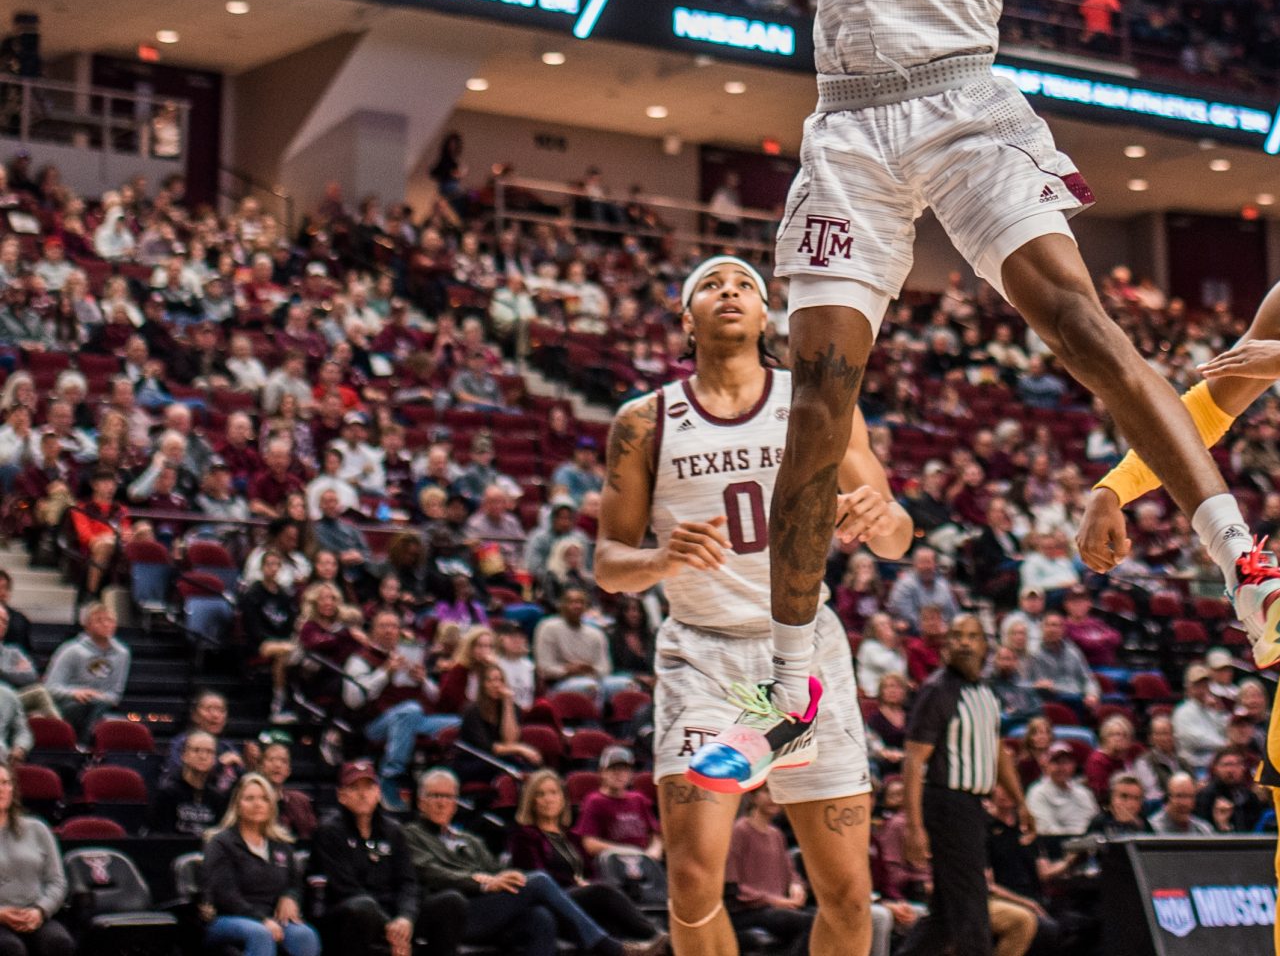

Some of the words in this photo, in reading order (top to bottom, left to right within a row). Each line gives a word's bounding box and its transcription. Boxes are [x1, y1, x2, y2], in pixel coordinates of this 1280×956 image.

[672, 6, 796, 56] NISSAN
[671, 448, 750, 480] TEXAS
[723, 480, 770, 555] 0
[1190, 884, 1277, 927] MUSCL
